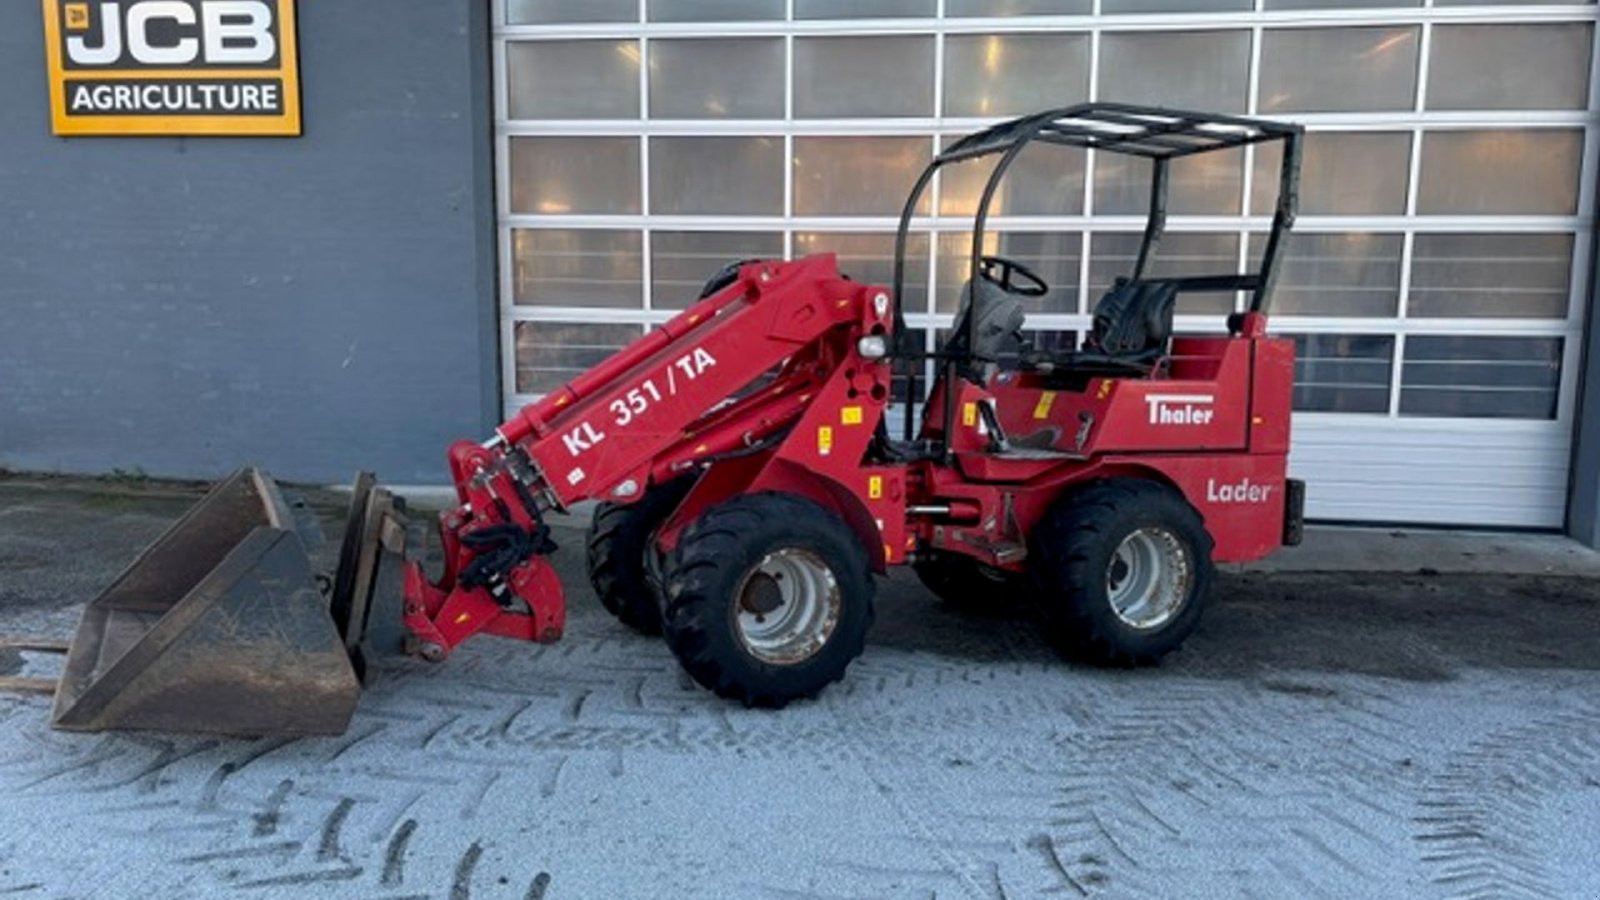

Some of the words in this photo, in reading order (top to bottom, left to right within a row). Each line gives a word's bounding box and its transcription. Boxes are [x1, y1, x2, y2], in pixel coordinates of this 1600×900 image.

[66, 1, 276, 64] JCB
[72, 85, 278, 110] AGRICULTURE
[1145, 394, 1214, 424] Thaler
[562, 421, 605, 457] KL
[1207, 478, 1272, 502] Lader
